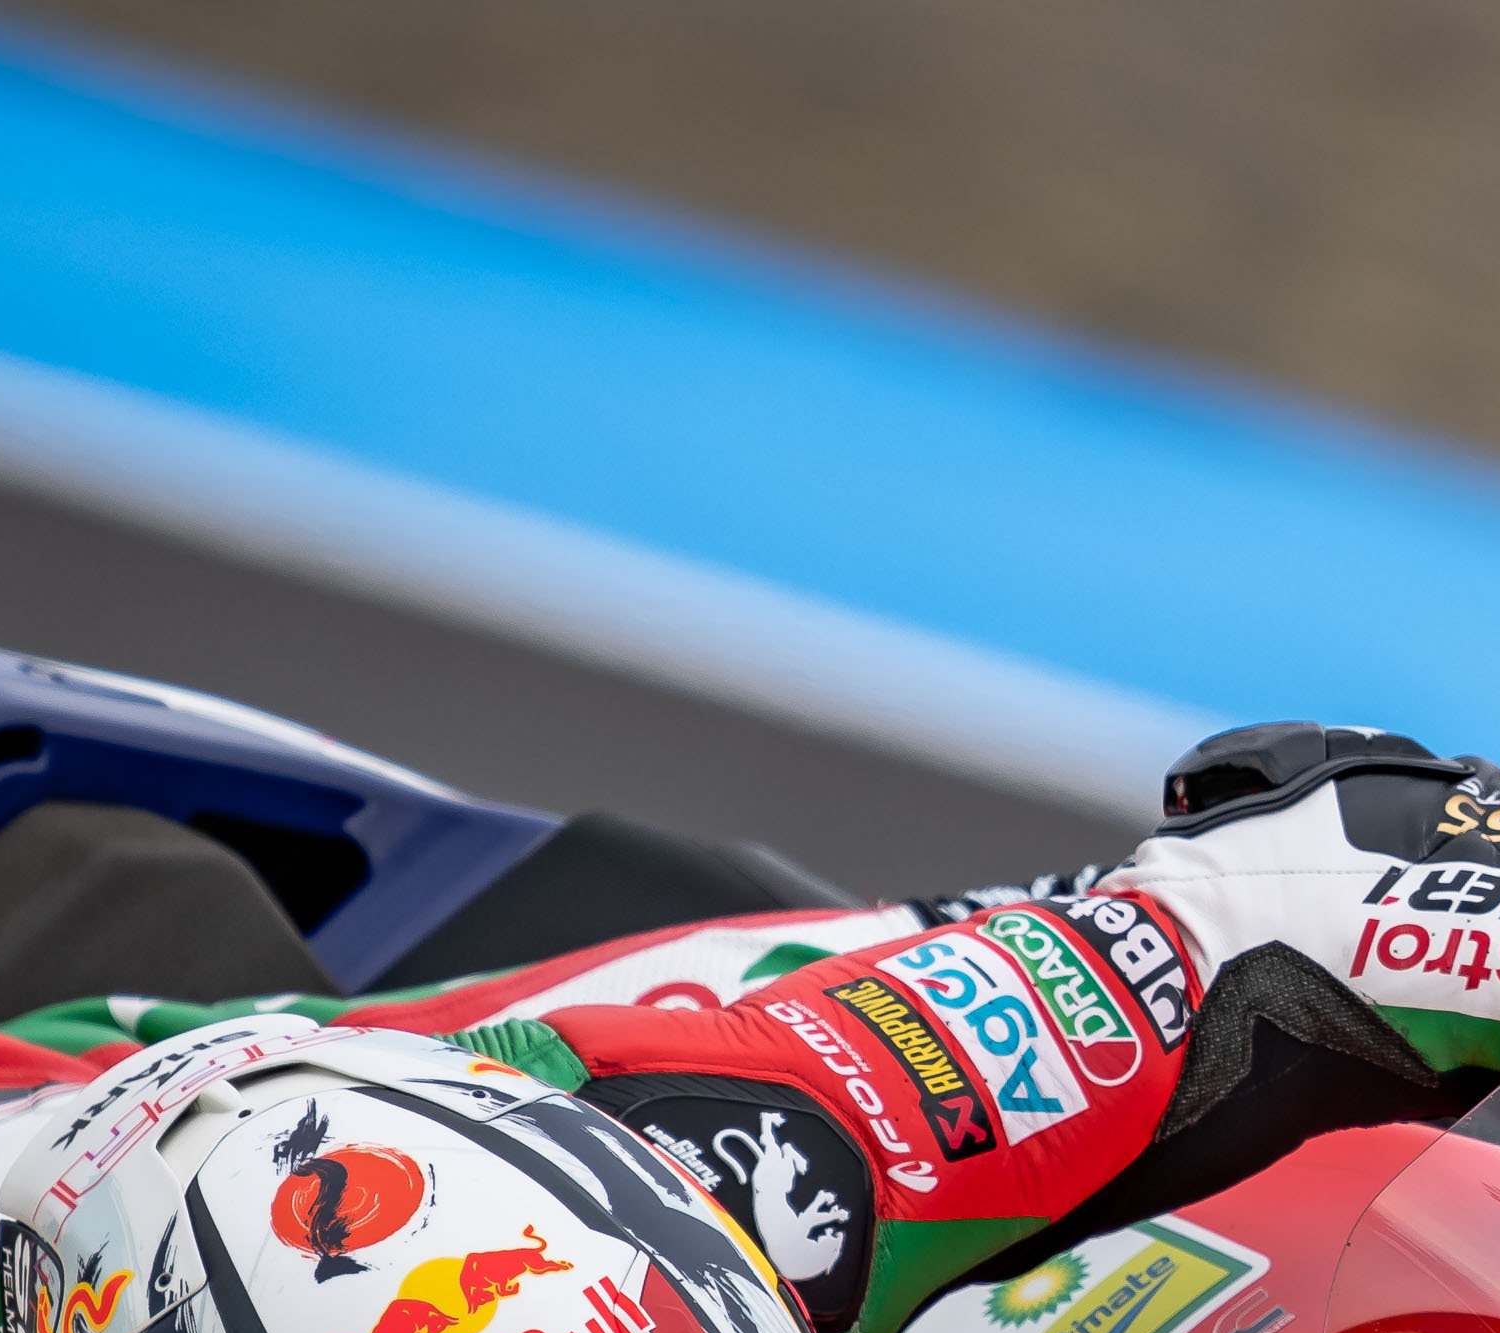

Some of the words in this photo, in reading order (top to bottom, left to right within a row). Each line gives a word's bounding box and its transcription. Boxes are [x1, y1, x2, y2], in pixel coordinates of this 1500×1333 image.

[899, 940, 1066, 1118] Agos
[994, 915, 1117, 1048] DRACO
[51, 1030, 258, 1151] SHARK
